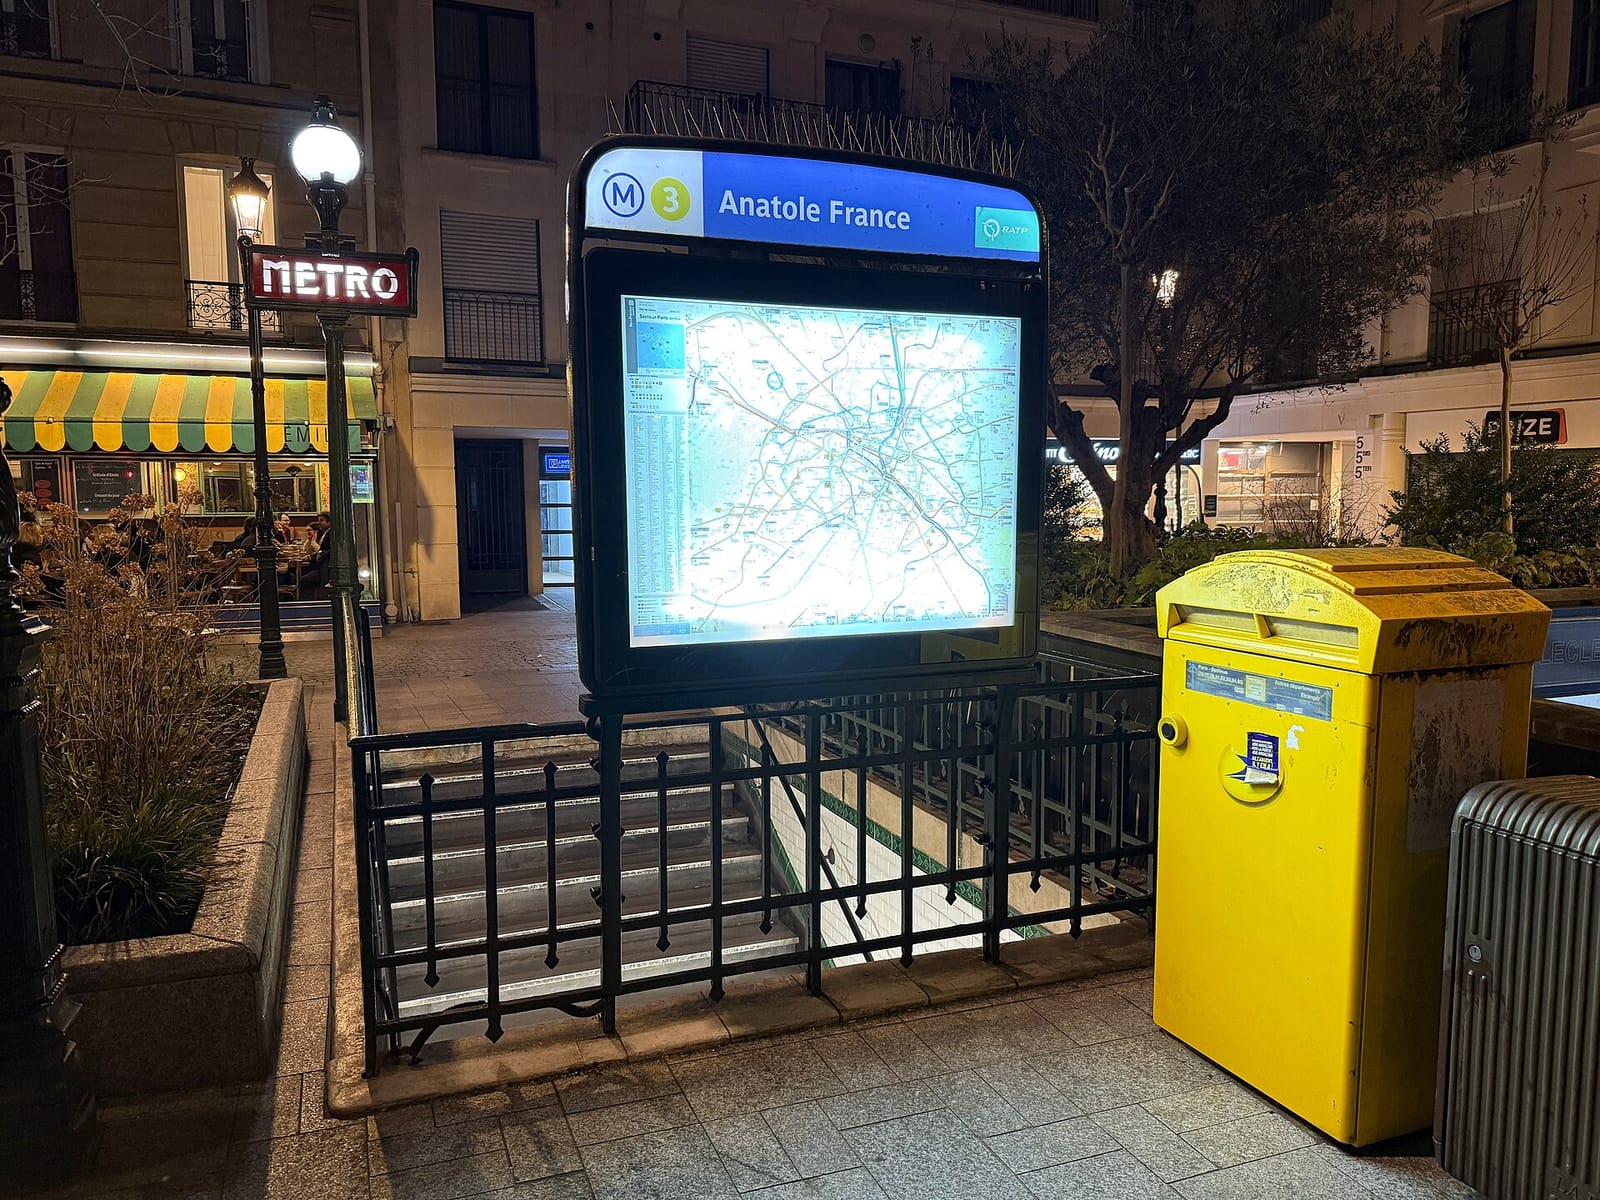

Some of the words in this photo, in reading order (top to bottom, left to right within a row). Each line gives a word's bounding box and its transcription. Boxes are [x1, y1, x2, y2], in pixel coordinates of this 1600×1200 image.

[663, 186, 680, 213] 3
[718, 189, 820, 223] Anatole
[829, 200, 911, 230] France
[1001, 225, 1029, 236] RATP
[262, 258, 399, 299] METRO
[284, 424, 329, 443] ÉMIL
[1356, 436, 1364, 449] 5
